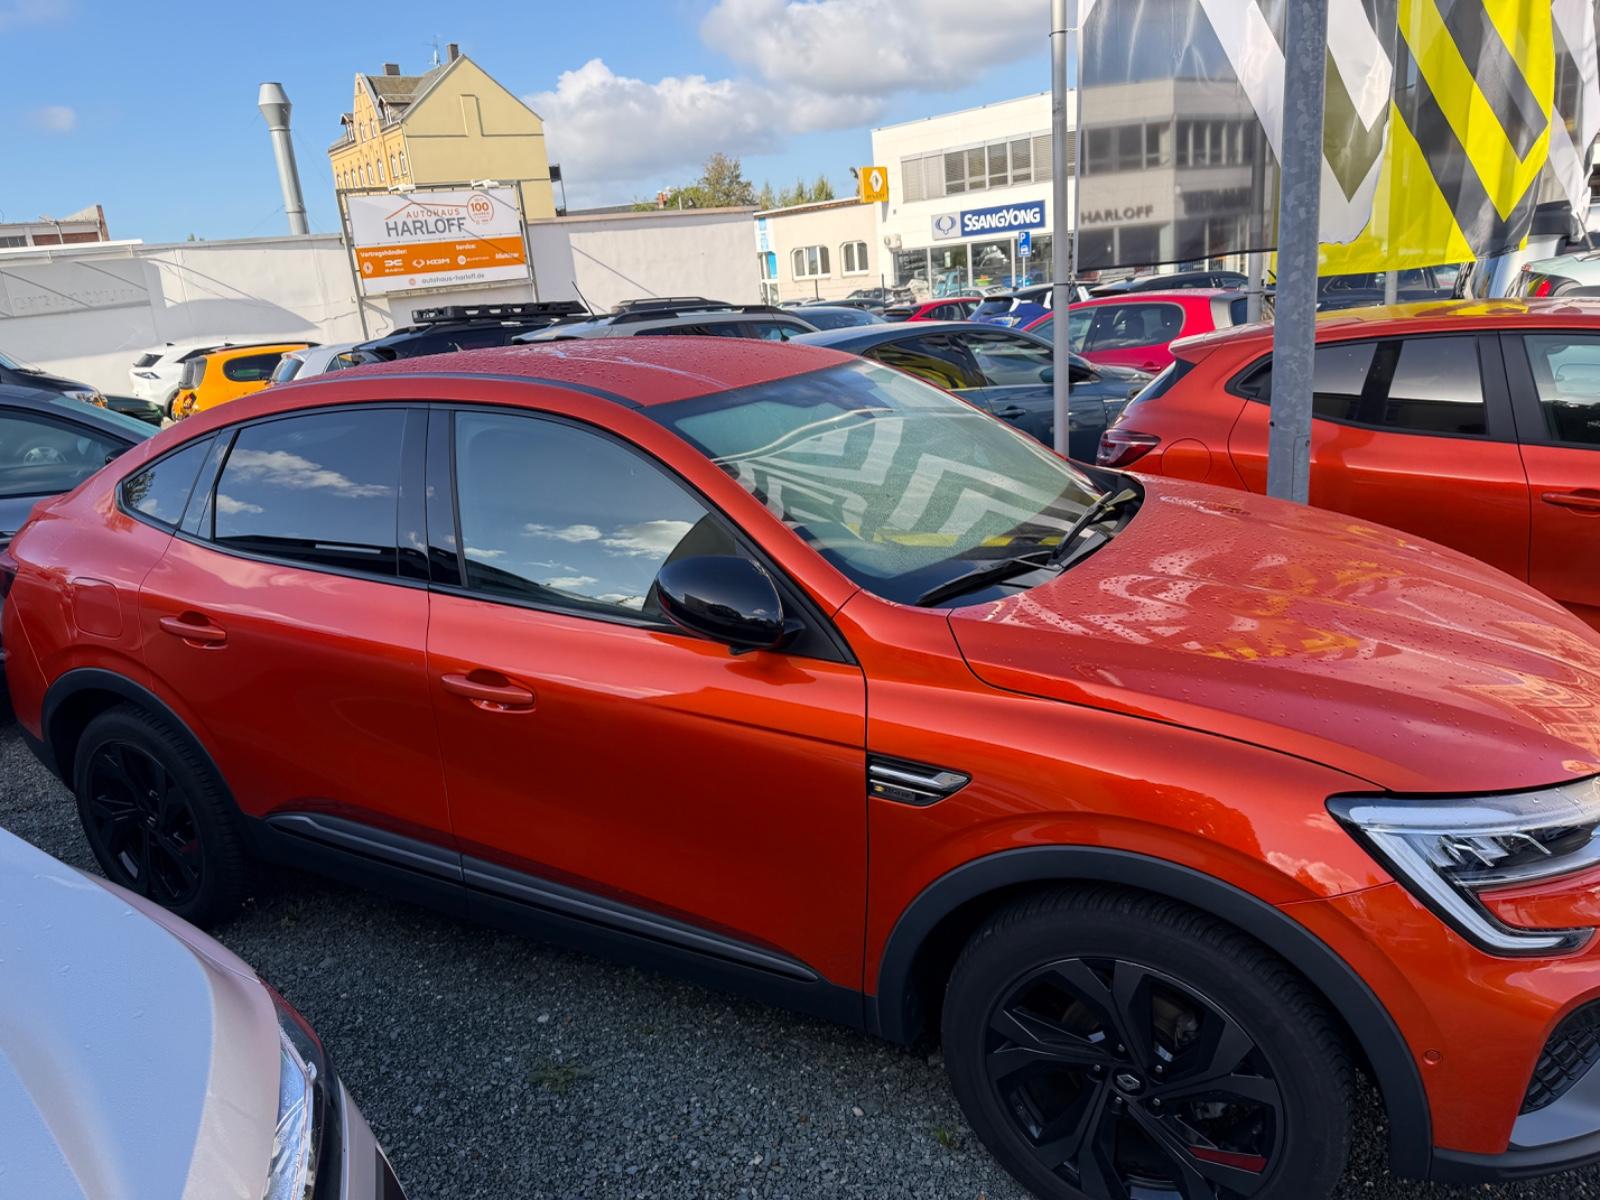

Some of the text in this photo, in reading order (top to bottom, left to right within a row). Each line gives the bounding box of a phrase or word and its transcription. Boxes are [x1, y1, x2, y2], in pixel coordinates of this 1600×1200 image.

[406, 207, 461, 219] AUTOHAUS
[471, 201, 489, 212] 100
[1080, 205, 1154, 224] HARLOFF
[385, 216, 466, 238] HARLOFF
